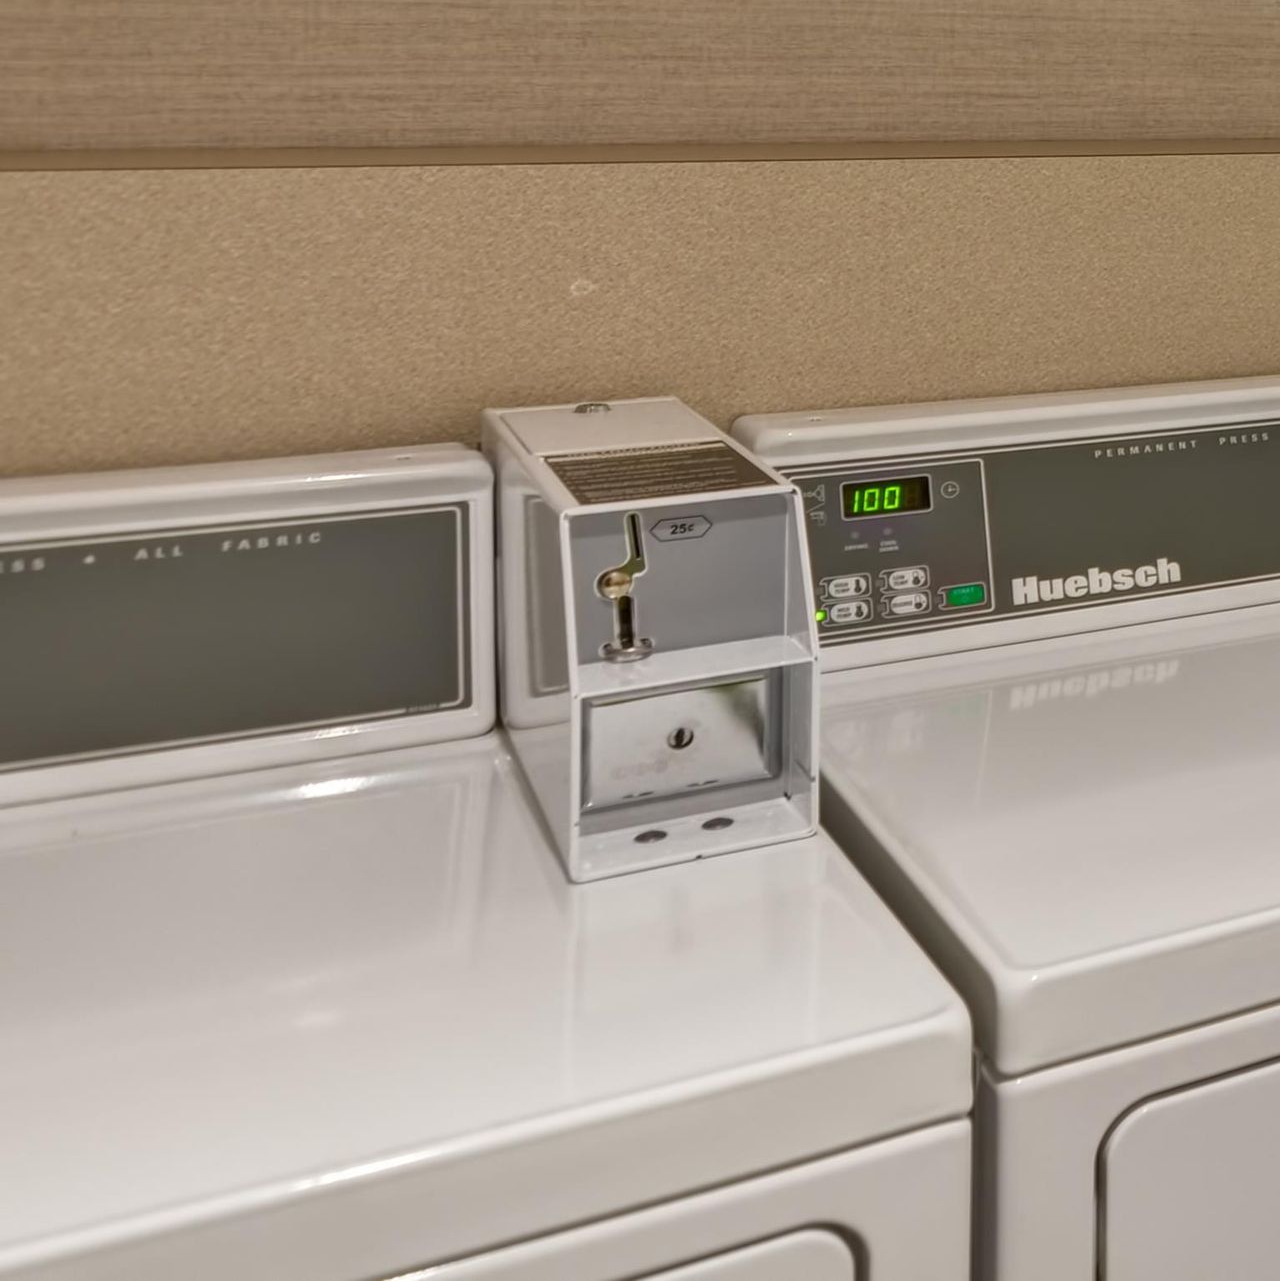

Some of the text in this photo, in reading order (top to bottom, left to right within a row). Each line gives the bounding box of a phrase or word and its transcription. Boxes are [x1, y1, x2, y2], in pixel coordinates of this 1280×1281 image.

[1093, 440, 1198, 459] PERMANENT
[1218, 432, 1271, 446] PRESS
[853, 486, 900, 513] 100
[133, 544, 184, 561] ALL
[220, 531, 321, 553] FABRIC
[1011, 557, 1181, 606] Huebsch
